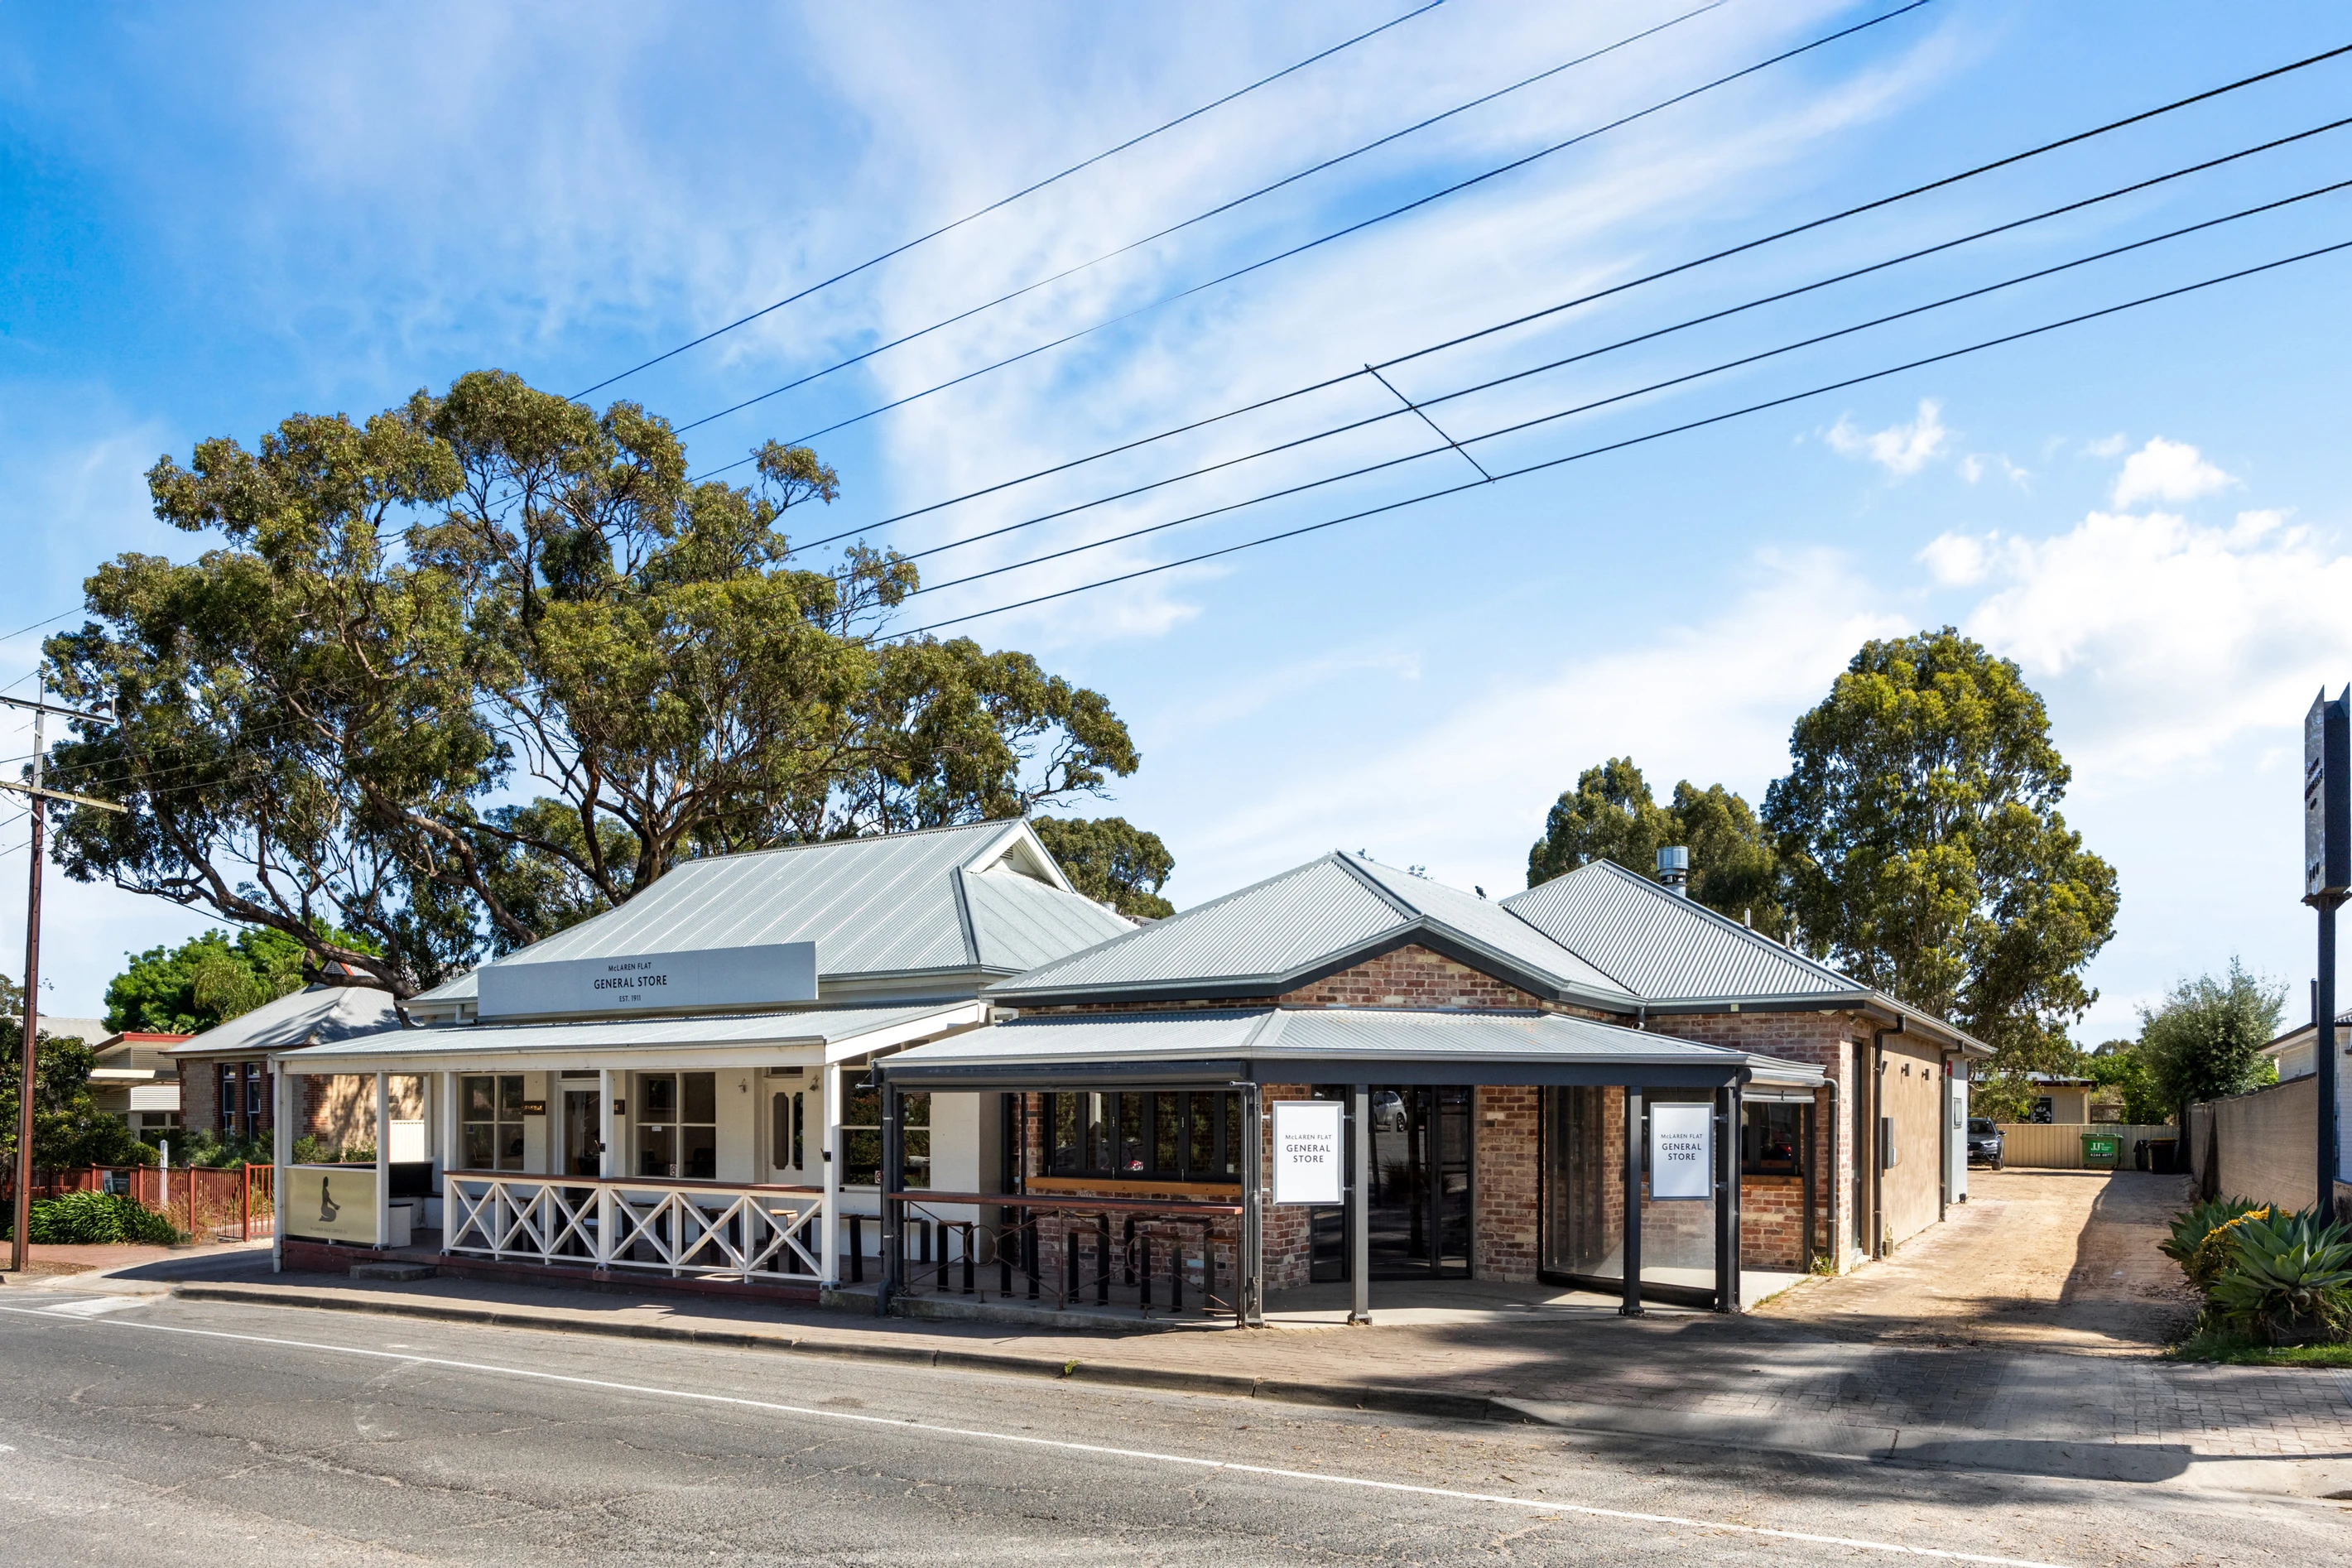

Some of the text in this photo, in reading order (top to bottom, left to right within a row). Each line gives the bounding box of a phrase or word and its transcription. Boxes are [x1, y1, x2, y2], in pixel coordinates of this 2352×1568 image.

[608, 964, 636, 972] McLAREN
[594, 975, 667, 989] GENERAL STORE
[1286, 1144, 1331, 1152] GENERAL
[1662, 1142, 1702, 1151] GENERAL
[1293, 1155, 1324, 1163] STORE
[1668, 1152, 1695, 1161] STORE
